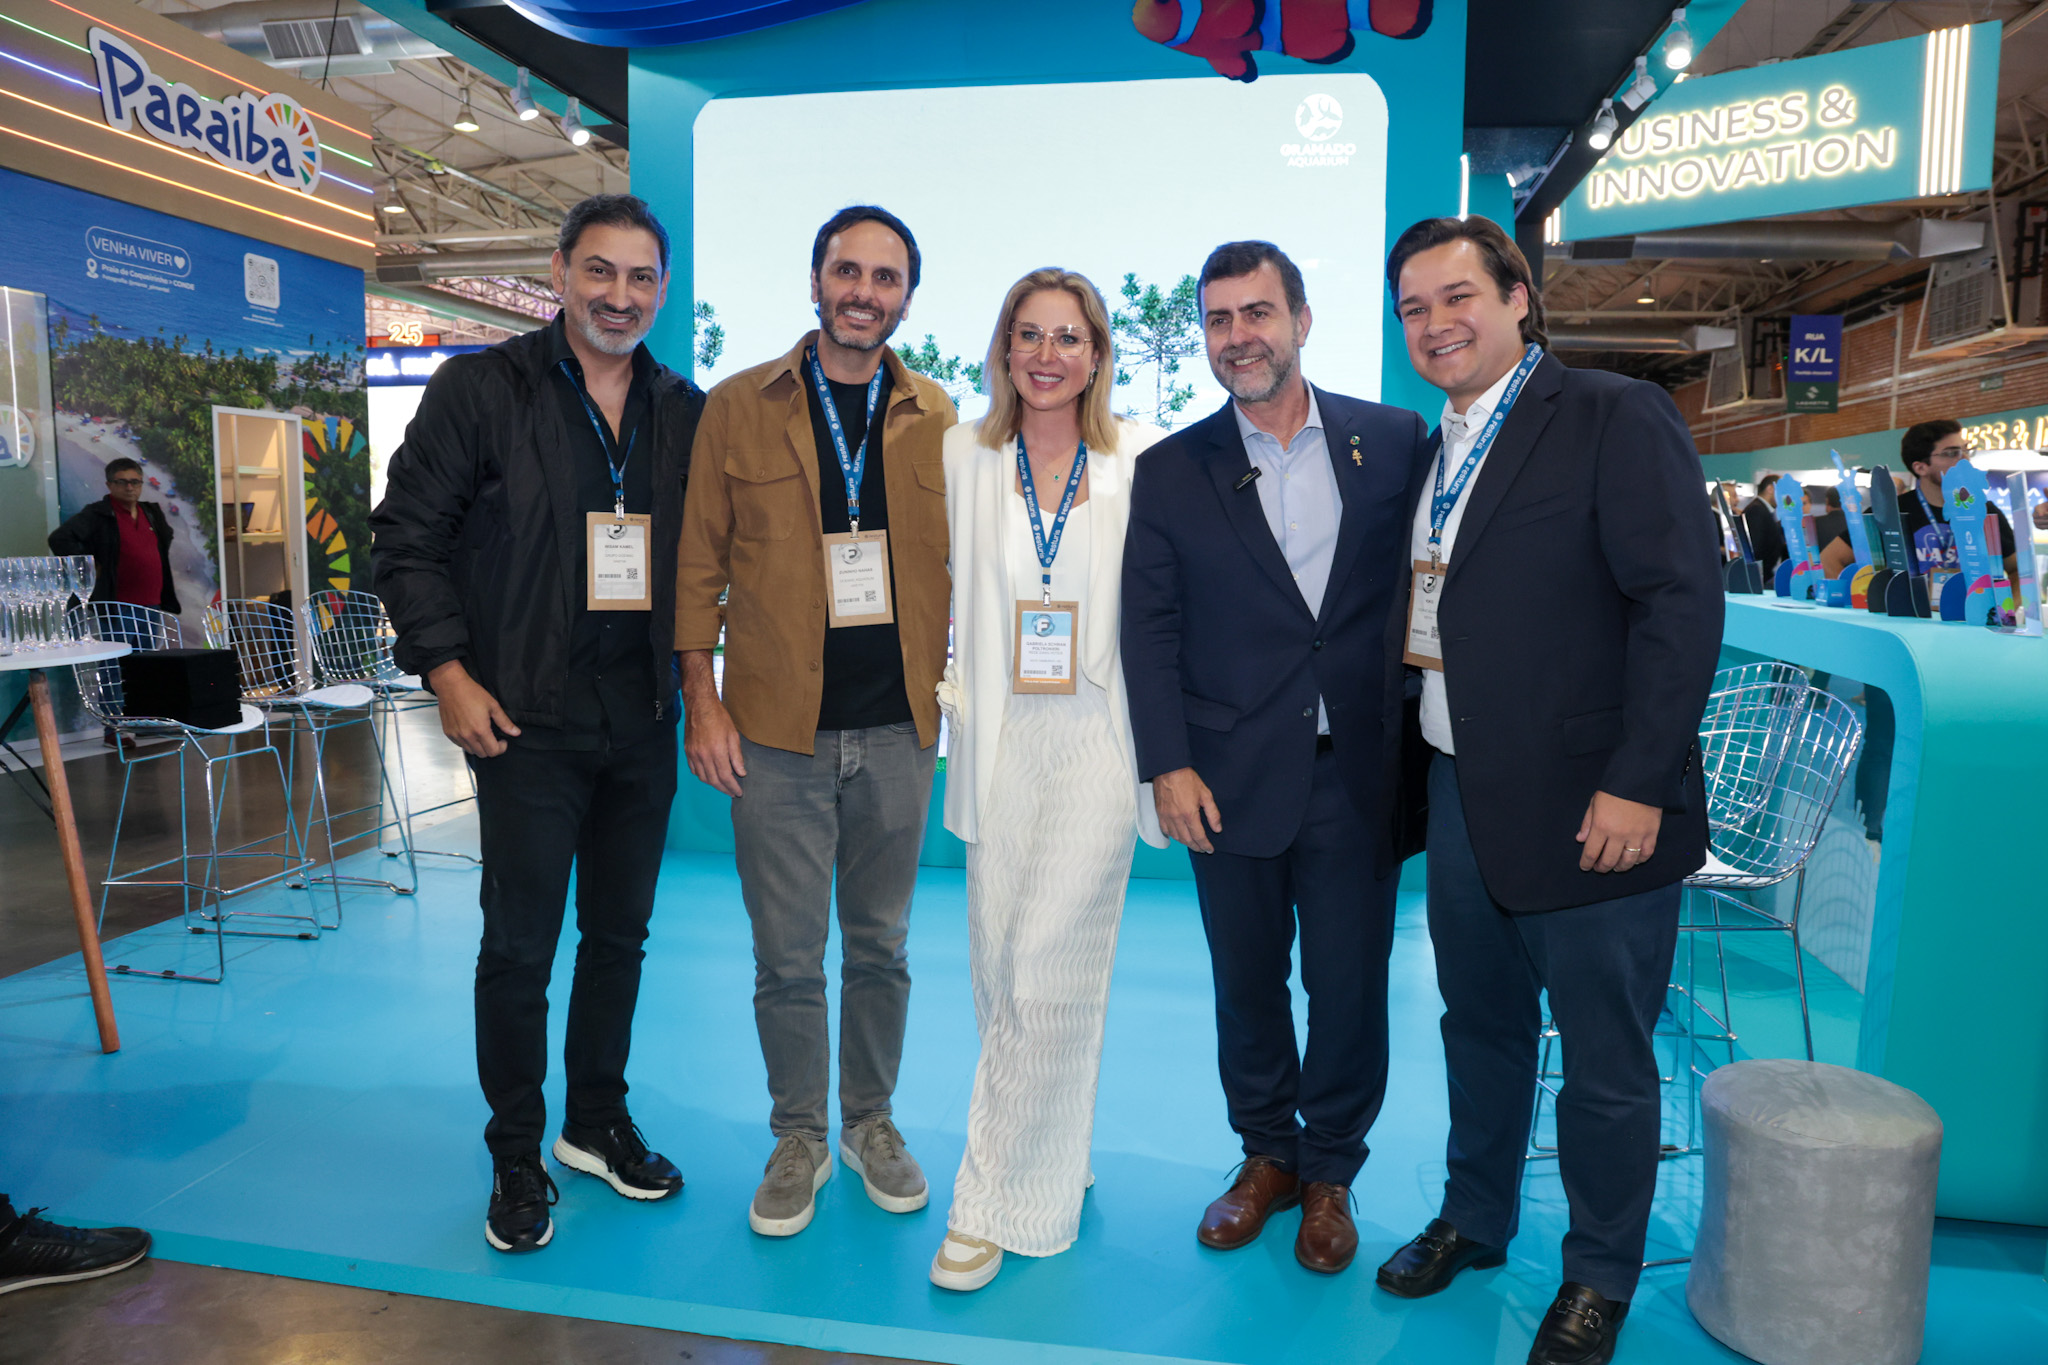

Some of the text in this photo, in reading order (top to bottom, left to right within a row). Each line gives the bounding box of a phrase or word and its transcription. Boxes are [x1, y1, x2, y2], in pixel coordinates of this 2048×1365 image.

[1602, 86, 1856, 158] USINESS &
[1280, 143, 1357, 156] GRAMADO
[1287, 156, 1350, 168] AQUARIUM
[1588, 125, 1894, 207] INNOVATION
[91, 235, 173, 266] VENHA VIVER
[1804, 332, 1826, 341] RUA
[1794, 347, 1834, 363] K/L
[1502, 375, 1522, 405] Festuris
[1475, 419, 1498, 450] Festuris
[836, 436, 849, 463] Festuris
[1449, 465, 1470, 495] Festuris
[1060, 491, 1074, 516] Festuris
[1434, 509, 1446, 529] Festu
[1048, 529, 1061, 556] Festuris
[1915, 547, 1960, 563] NAS
